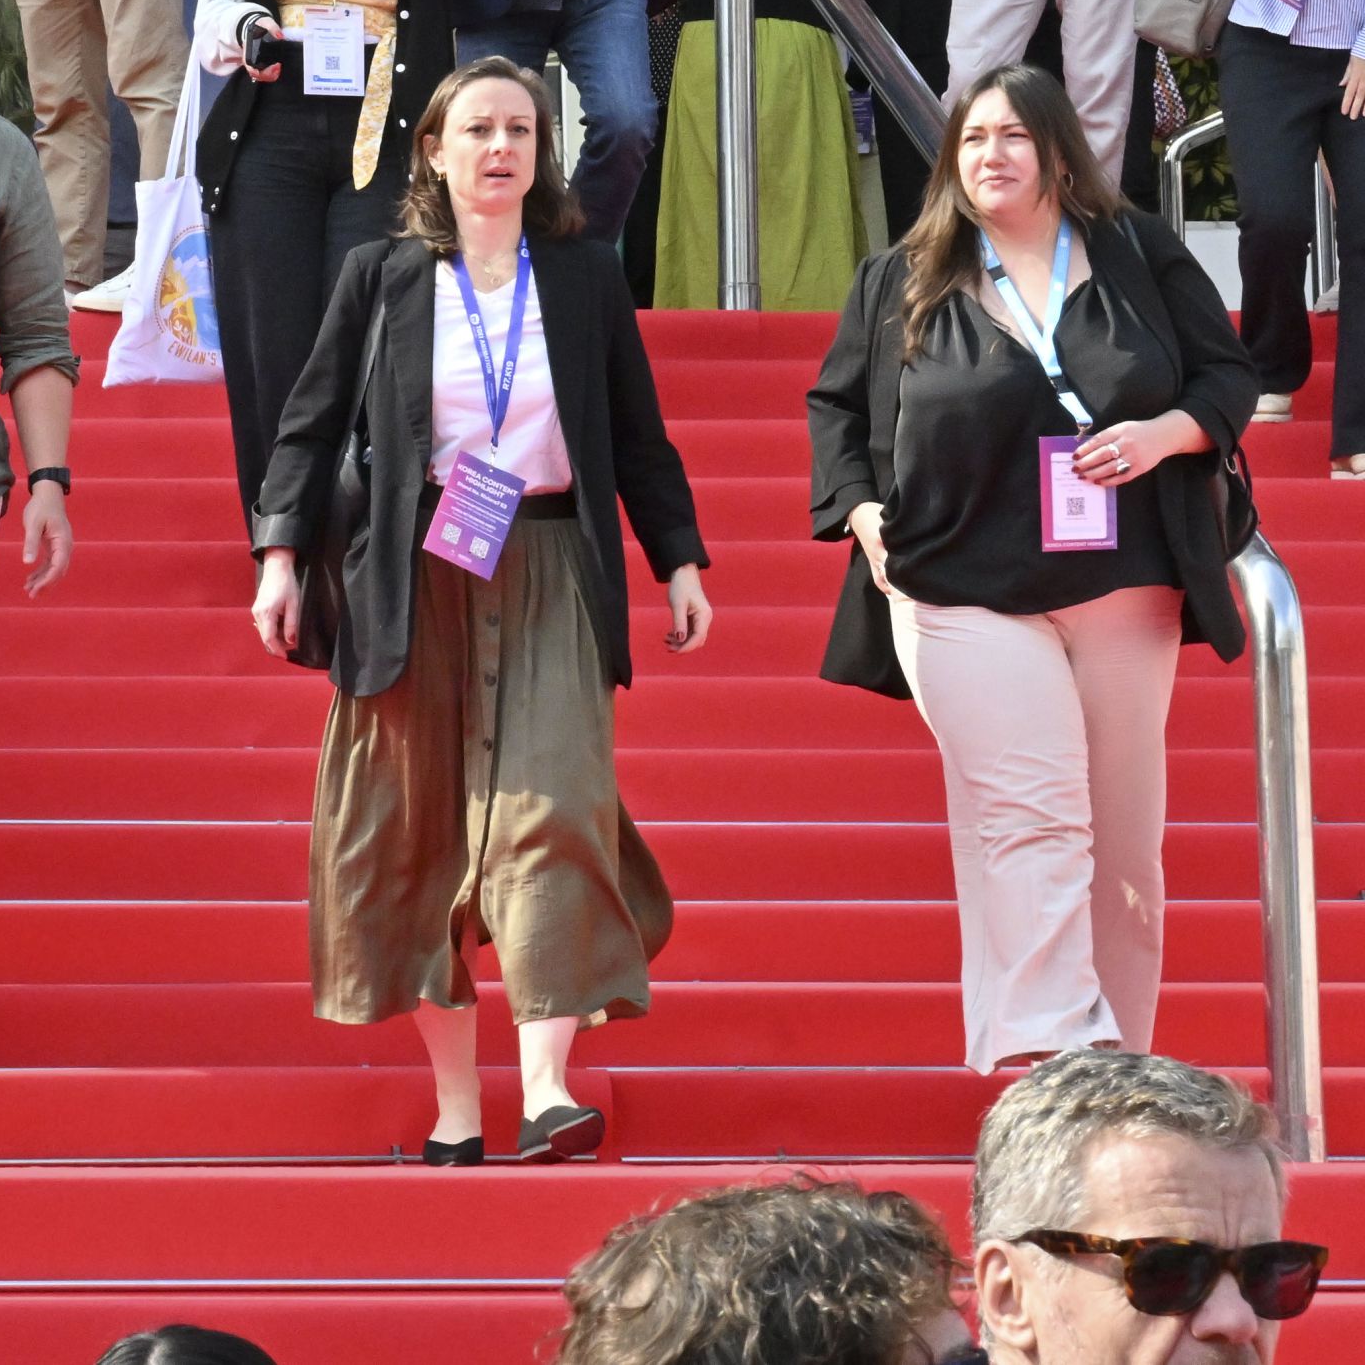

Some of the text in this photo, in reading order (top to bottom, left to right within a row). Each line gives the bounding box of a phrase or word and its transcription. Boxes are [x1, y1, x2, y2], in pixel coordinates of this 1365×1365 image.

[167, 339, 218, 367] EWILAN'S
[502, 360, 514, 391] R7.K19
[457, 463, 519, 497] KOREA CONTENT
[465, 475, 505, 498] HIGHLIGHT
